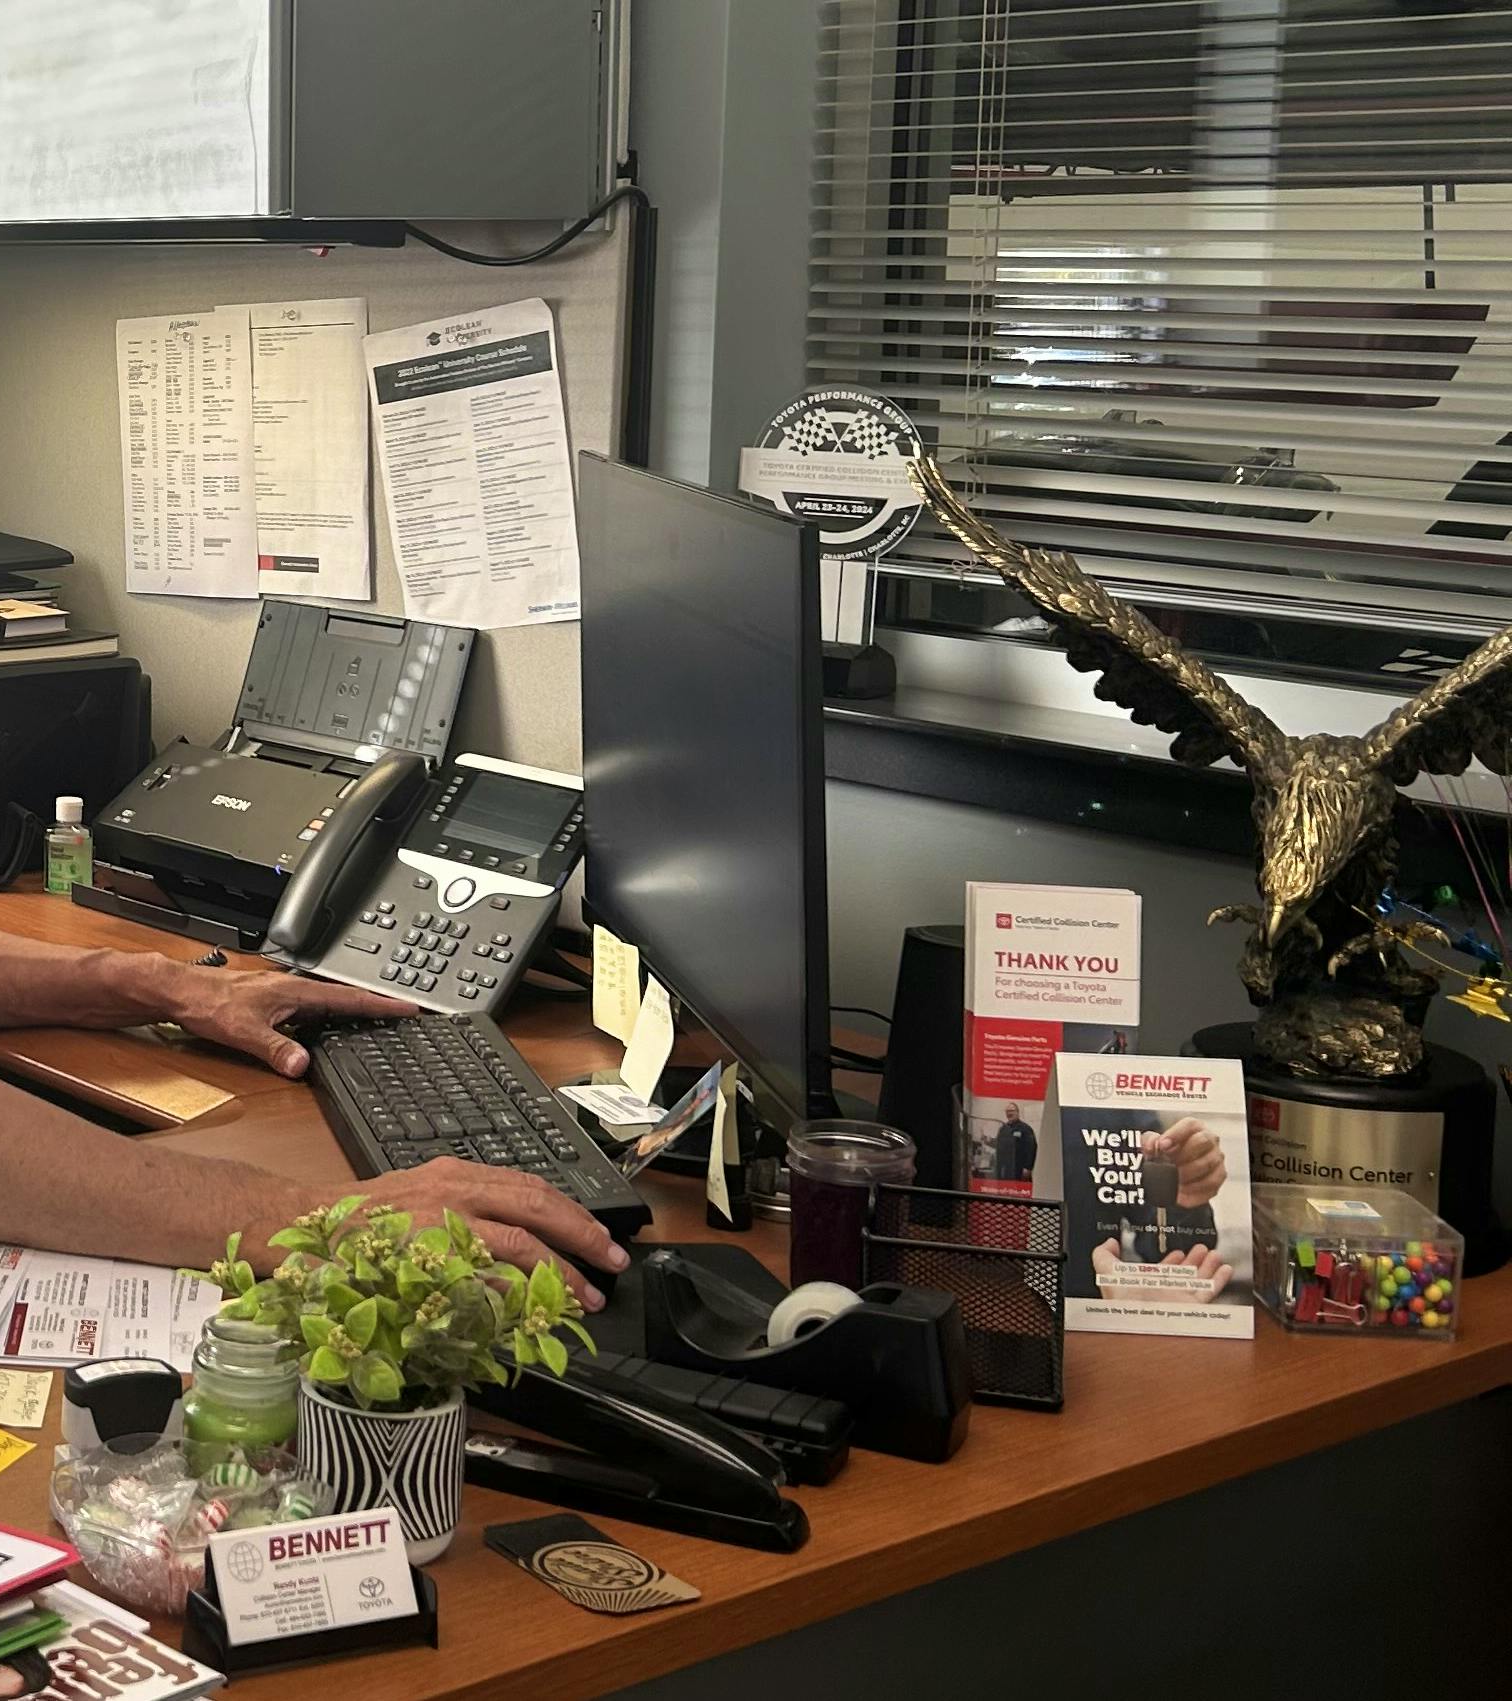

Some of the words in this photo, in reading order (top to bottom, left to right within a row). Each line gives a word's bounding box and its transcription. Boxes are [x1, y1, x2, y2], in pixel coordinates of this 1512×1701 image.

[772, 401, 807, 428] TOYOTA
[808, 391, 884, 410] PERFORMANCE
[884, 406, 914, 435] GROUP
[759, 470, 816, 480] PERFORMANCE
[763, 462, 794, 470] TOYOTA
[796, 464, 836, 473] CERTIFIED
[881, 468, 906, 477] CENTE
[795, 501, 820, 512] APRIL
[851, 504, 874, 515] 2024
[212, 794, 252, 811] EPSON
[1016, 916, 1052, 926] Certified
[1054, 918, 1090, 927] Collision
[1092, 920, 1120, 928] Center
[994, 952, 1070, 971] THANK
[1074, 956, 1118, 974] YOU
[995, 976, 1012, 986] For
[1015, 978, 1061, 992] choosing
[1064, 982, 1070, 990] a
[1072, 981, 1106, 992] Toyota
[995, 990, 1040, 1001] Certified
[1042, 992, 1086, 1004] Collision
[1088, 995, 1122, 1006] Center
[1116, 1074, 1212, 1092] BENNETT
[1082, 1129, 1142, 1148] We'll
[1097, 1150, 1144, 1170] Buy
[1260, 1152, 1344, 1180] Collision
[1350, 1166, 1416, 1184] Center
[1090, 1167, 1142, 1186] Your
[1098, 1186, 1144, 1205] Car!
[1145, 1224, 1158, 1232] do
[1159, 1224, 1176, 1232] not
[1176, 1226, 1193, 1236] buy
[1114, 1265, 1126, 1273] Up
[1172, 1266, 1196, 1276] Kelley
[1120, 1278, 1140, 1286] Book
[268, 1519, 390, 1562] BENNETT
[358, 1598, 394, 1612] TOYOTA
